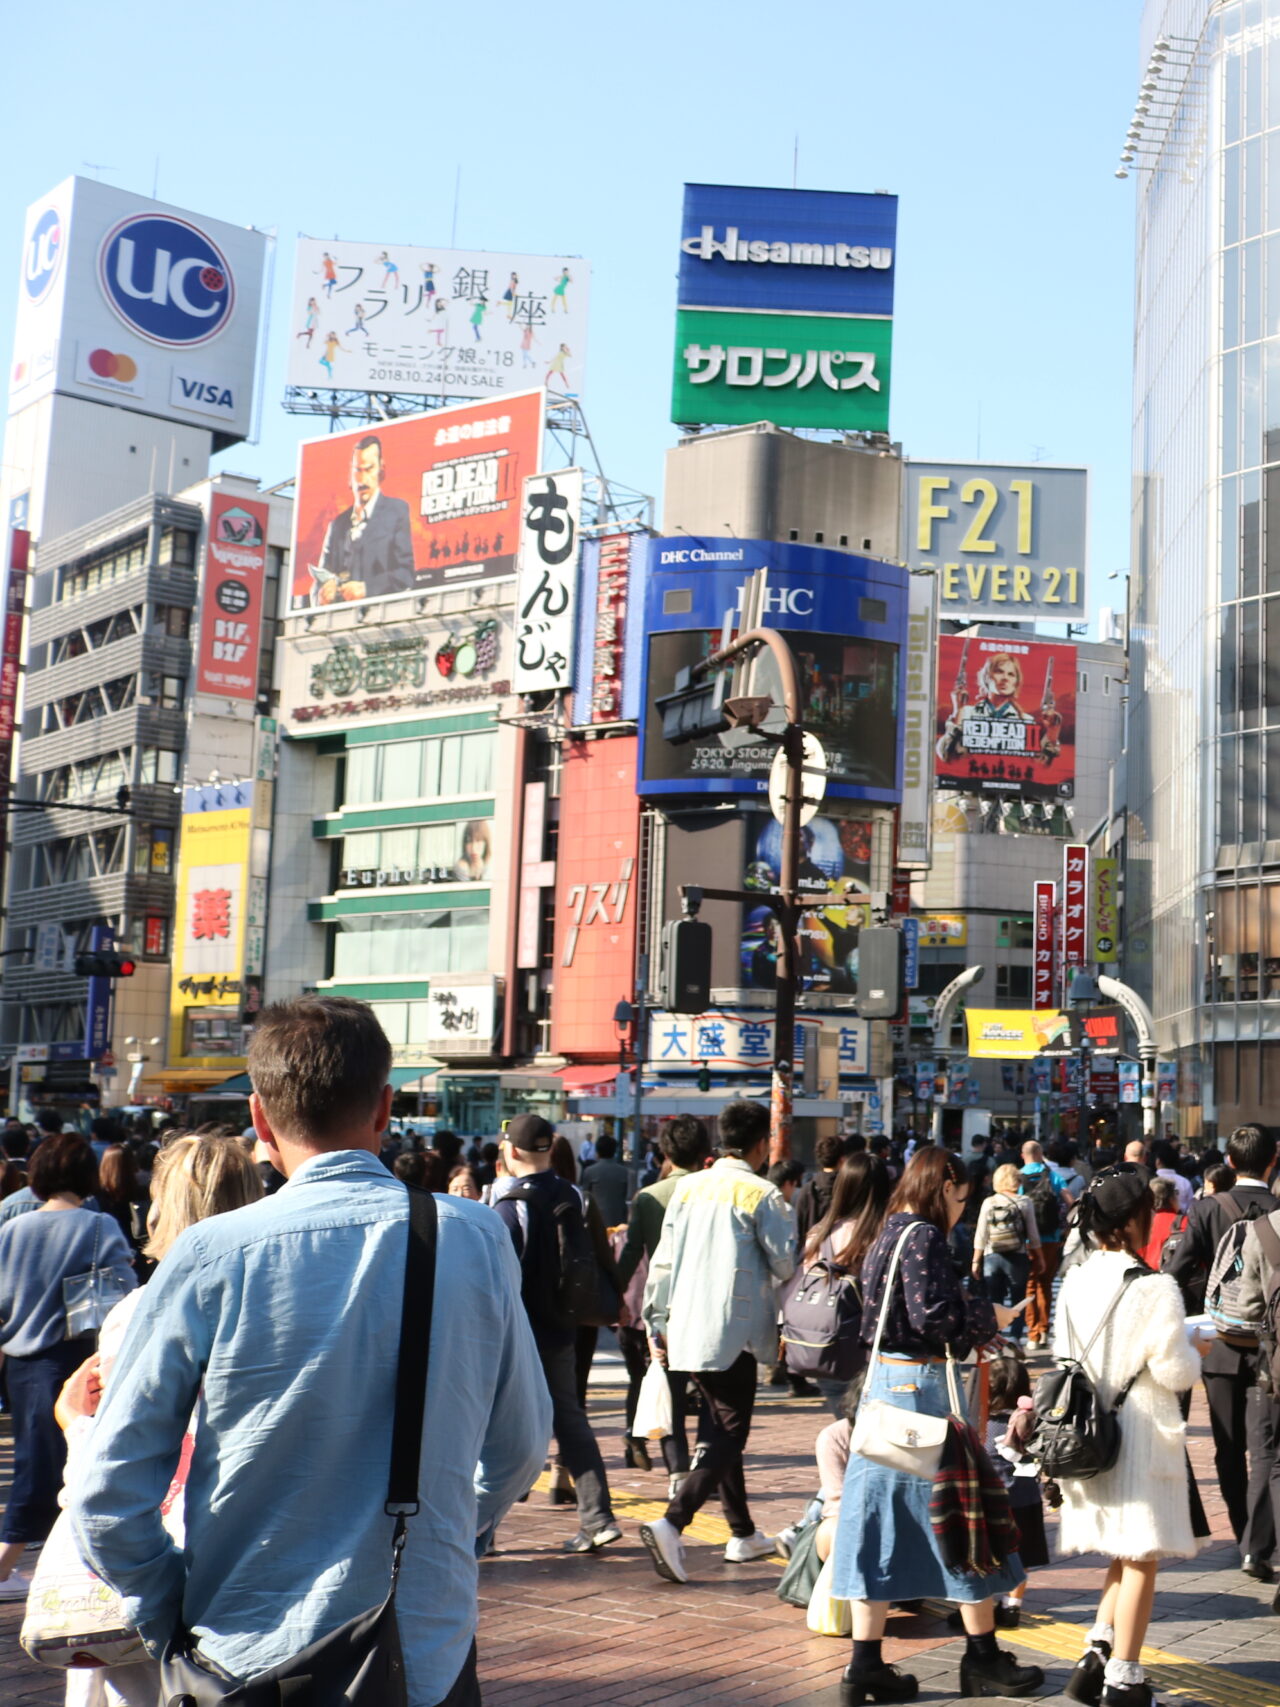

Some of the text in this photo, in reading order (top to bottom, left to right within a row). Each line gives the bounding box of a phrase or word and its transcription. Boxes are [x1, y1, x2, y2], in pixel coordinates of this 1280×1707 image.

[681, 226, 892, 269] Hisamitsu
[116, 237, 221, 318] UC
[368, 369, 504, 388] 2018.10.24 ON SALE
[684, 343, 880, 392] サロンパス
[177, 377, 234, 409] VISA
[422, 466, 455, 497] RED
[455, 458, 499, 491] DEAD
[420, 483, 497, 516] REDEMPTION
[917, 476, 1034, 555] F21
[660, 549, 743, 564] DHC Channel
[518, 477, 574, 681] もんじゃ
[942, 563, 1077, 603] EVER 21
[903, 606, 929, 789] Taisei neon
[962, 720, 989, 738] RED
[990, 721, 1026, 740] DEAD
[962, 735, 1026, 752] REDEMPTION
[695, 748, 774, 759] TOKYO STORE
[346, 866, 449, 888] Euphoria
[192, 888, 232, 941] 薬
[562, 857, 634, 967] クスリ
[1067, 858, 1084, 941] カラオケ
[1098, 939, 1112, 951] 4F
